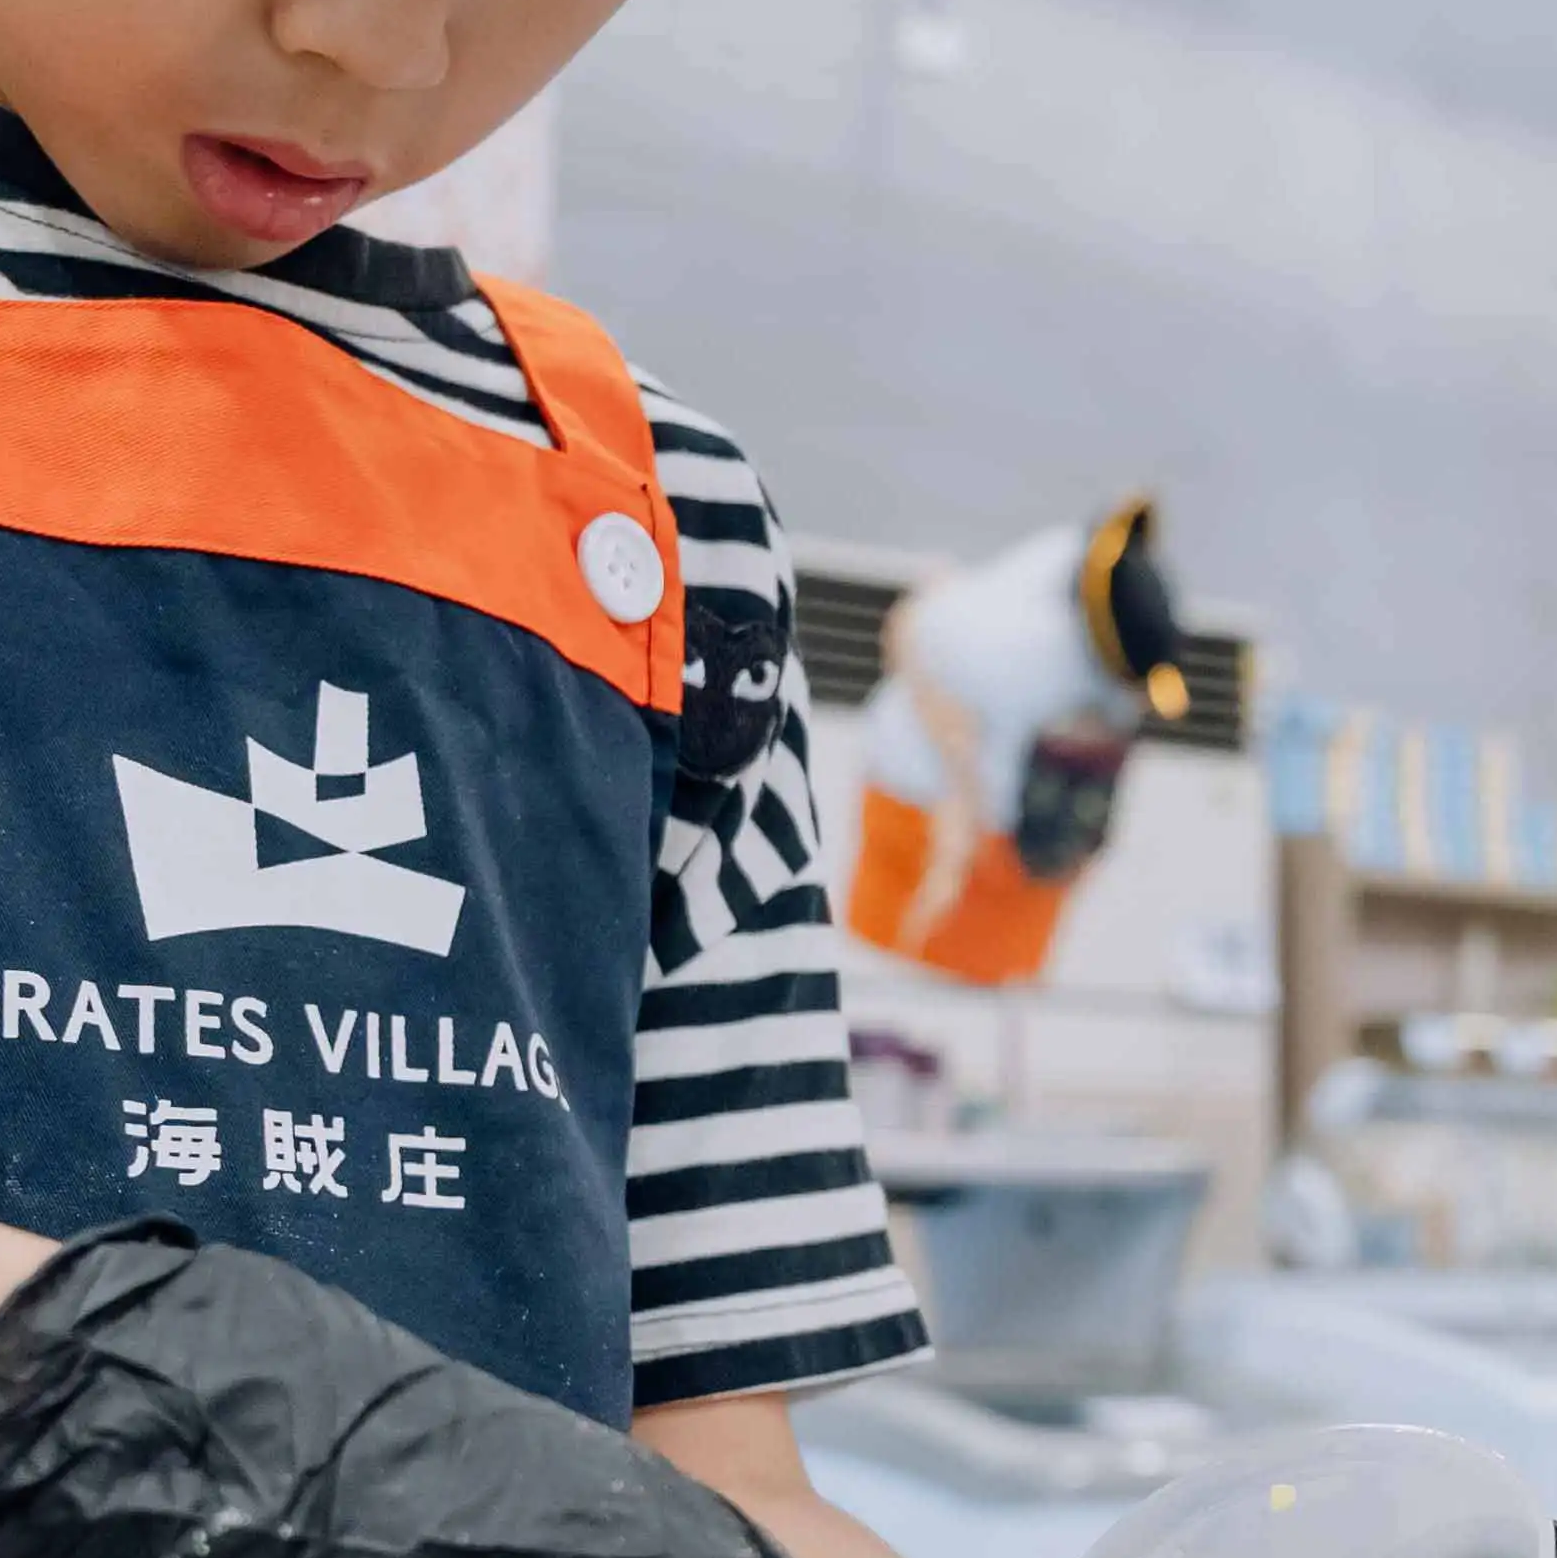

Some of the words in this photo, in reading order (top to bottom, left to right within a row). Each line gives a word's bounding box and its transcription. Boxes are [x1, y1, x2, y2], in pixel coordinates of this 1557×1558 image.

[305, 1004, 571, 1112] VILLAG
[122, 1099, 466, 1209] 海賊庄
